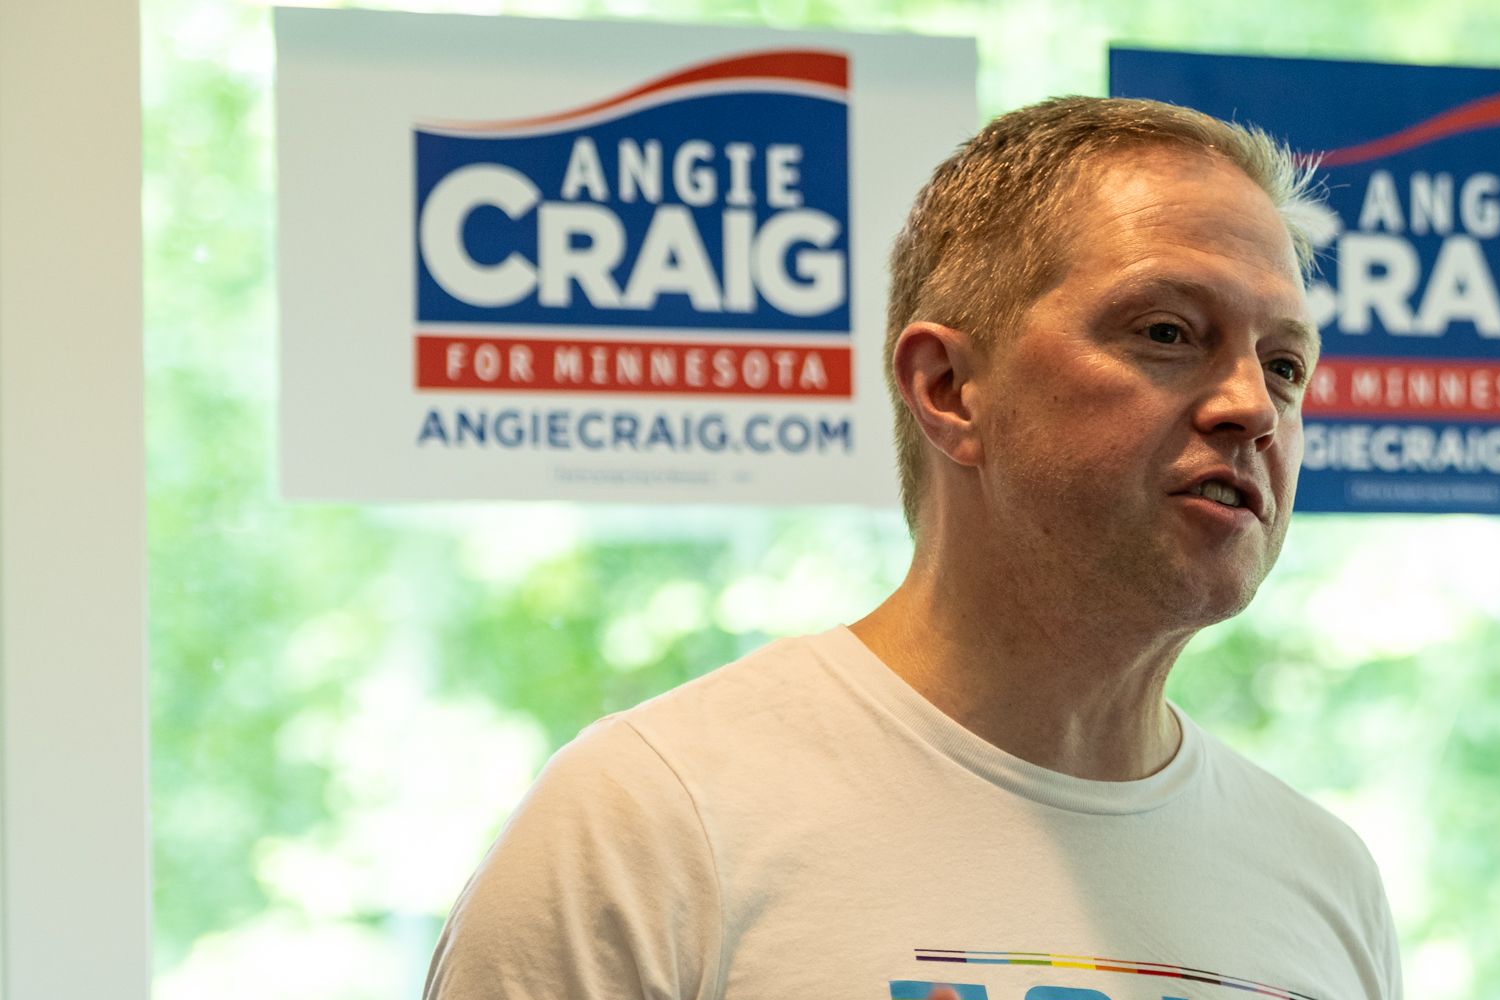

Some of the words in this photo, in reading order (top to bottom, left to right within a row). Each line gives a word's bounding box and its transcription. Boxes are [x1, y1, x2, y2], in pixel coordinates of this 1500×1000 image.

[560, 136, 803, 208] ANGIE
[419, 163, 845, 317] CRAIG
[445, 342, 534, 383] FOR
[552, 345, 829, 390] MINNESOTA
[416, 407, 853, 455] ANGIECRAIG.COM
